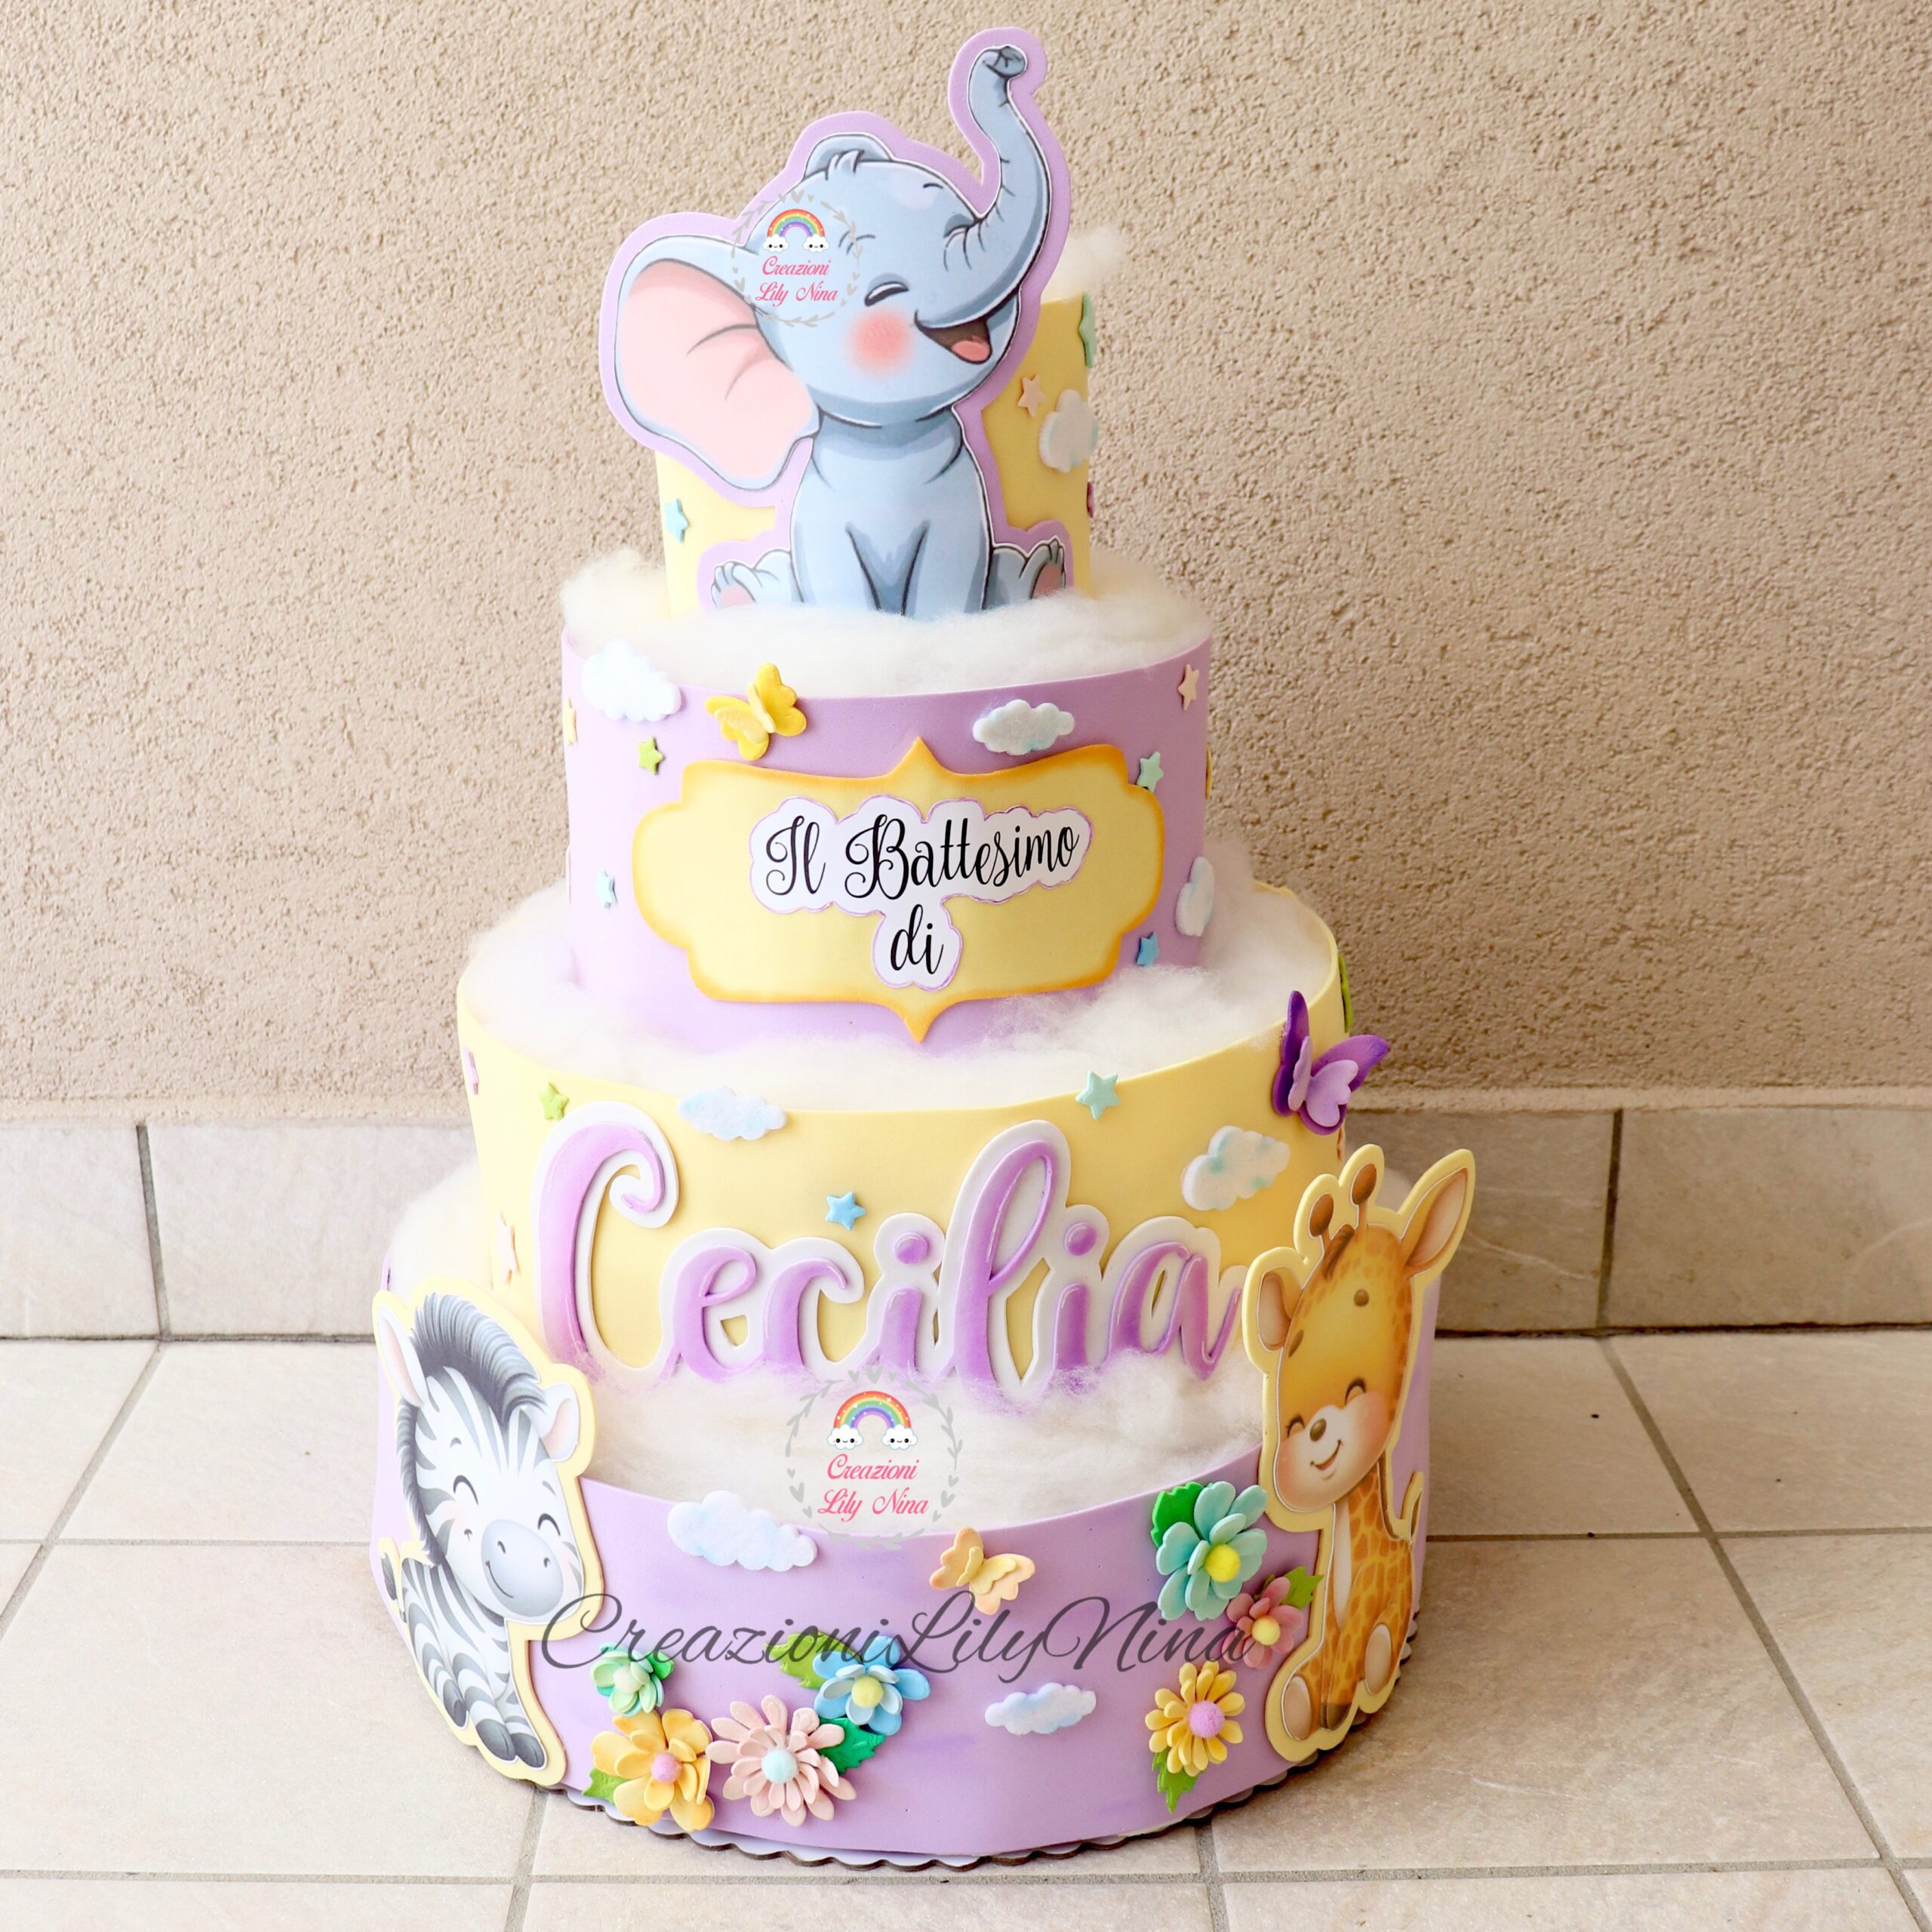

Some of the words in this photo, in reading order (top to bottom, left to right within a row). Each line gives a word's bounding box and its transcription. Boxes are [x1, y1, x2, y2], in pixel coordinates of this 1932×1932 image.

[765, 815, 826, 896] Il
[844, 814, 1079, 900] Battesimo
[890, 903, 944, 974] di
[537, 1119, 1242, 1395] Cecilia
